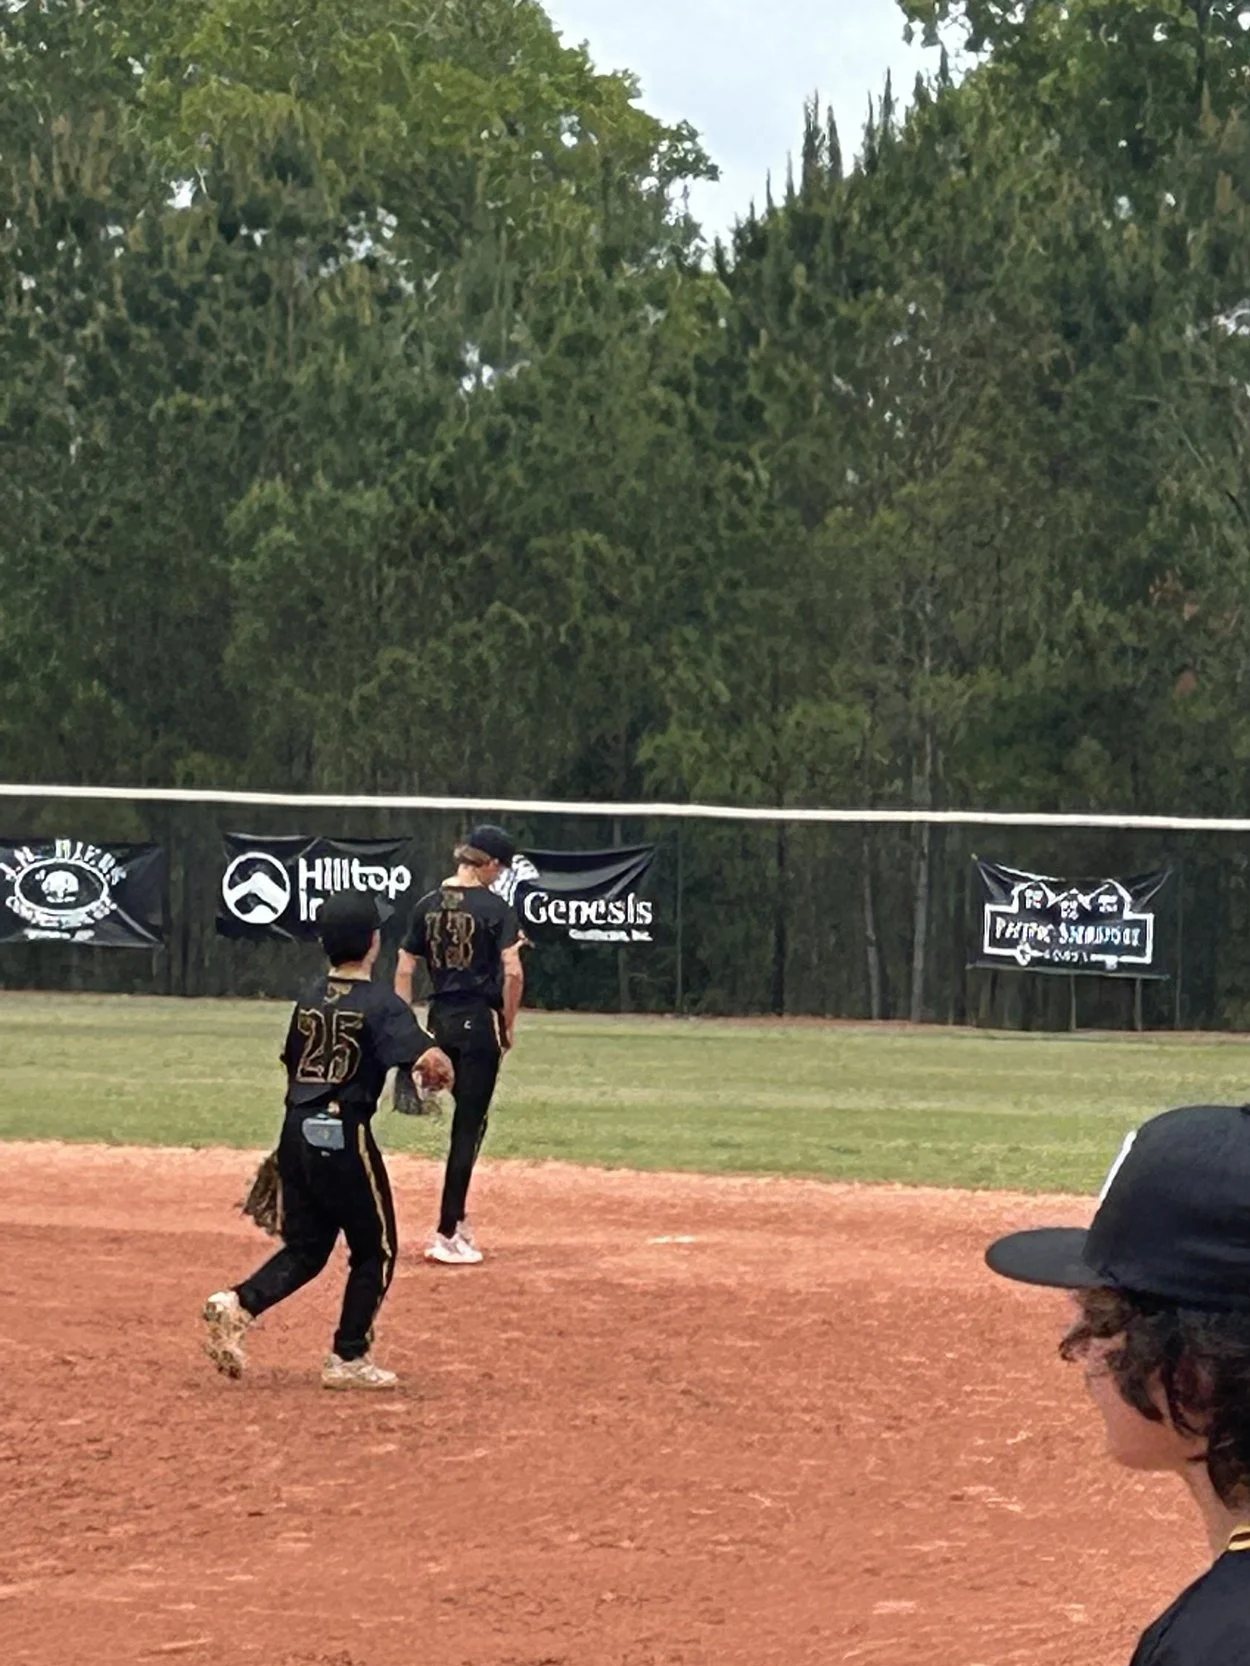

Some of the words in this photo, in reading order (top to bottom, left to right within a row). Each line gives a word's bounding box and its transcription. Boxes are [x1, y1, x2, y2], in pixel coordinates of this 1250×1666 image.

[298, 857, 412, 899] Hilltop
[523, 891, 653, 925] Genesis
[296, 1008, 365, 1083] 25
